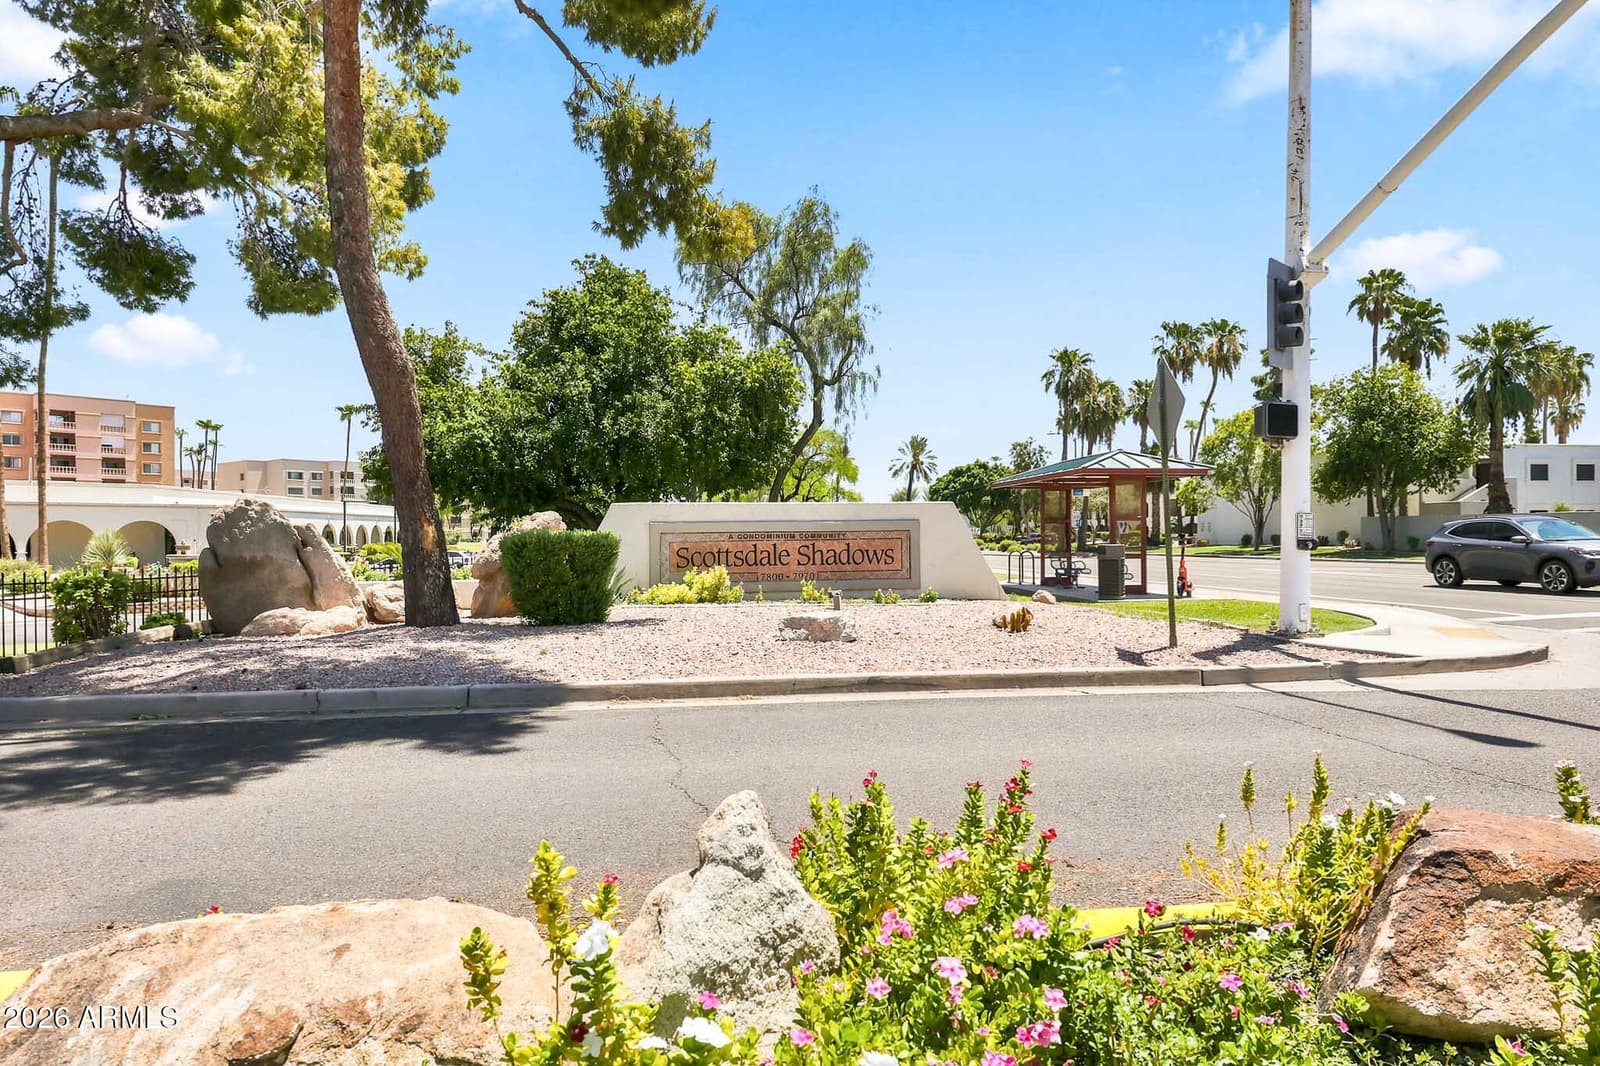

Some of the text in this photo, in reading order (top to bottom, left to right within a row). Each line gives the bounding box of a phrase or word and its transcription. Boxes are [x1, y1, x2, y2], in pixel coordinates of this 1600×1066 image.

[736, 532, 796, 540] CONDOMINIUM
[798, 531, 847, 539] COMMUNITY
[676, 542, 895, 569] Scottsdale Shadows
[760, 572, 784, 581] 7800
